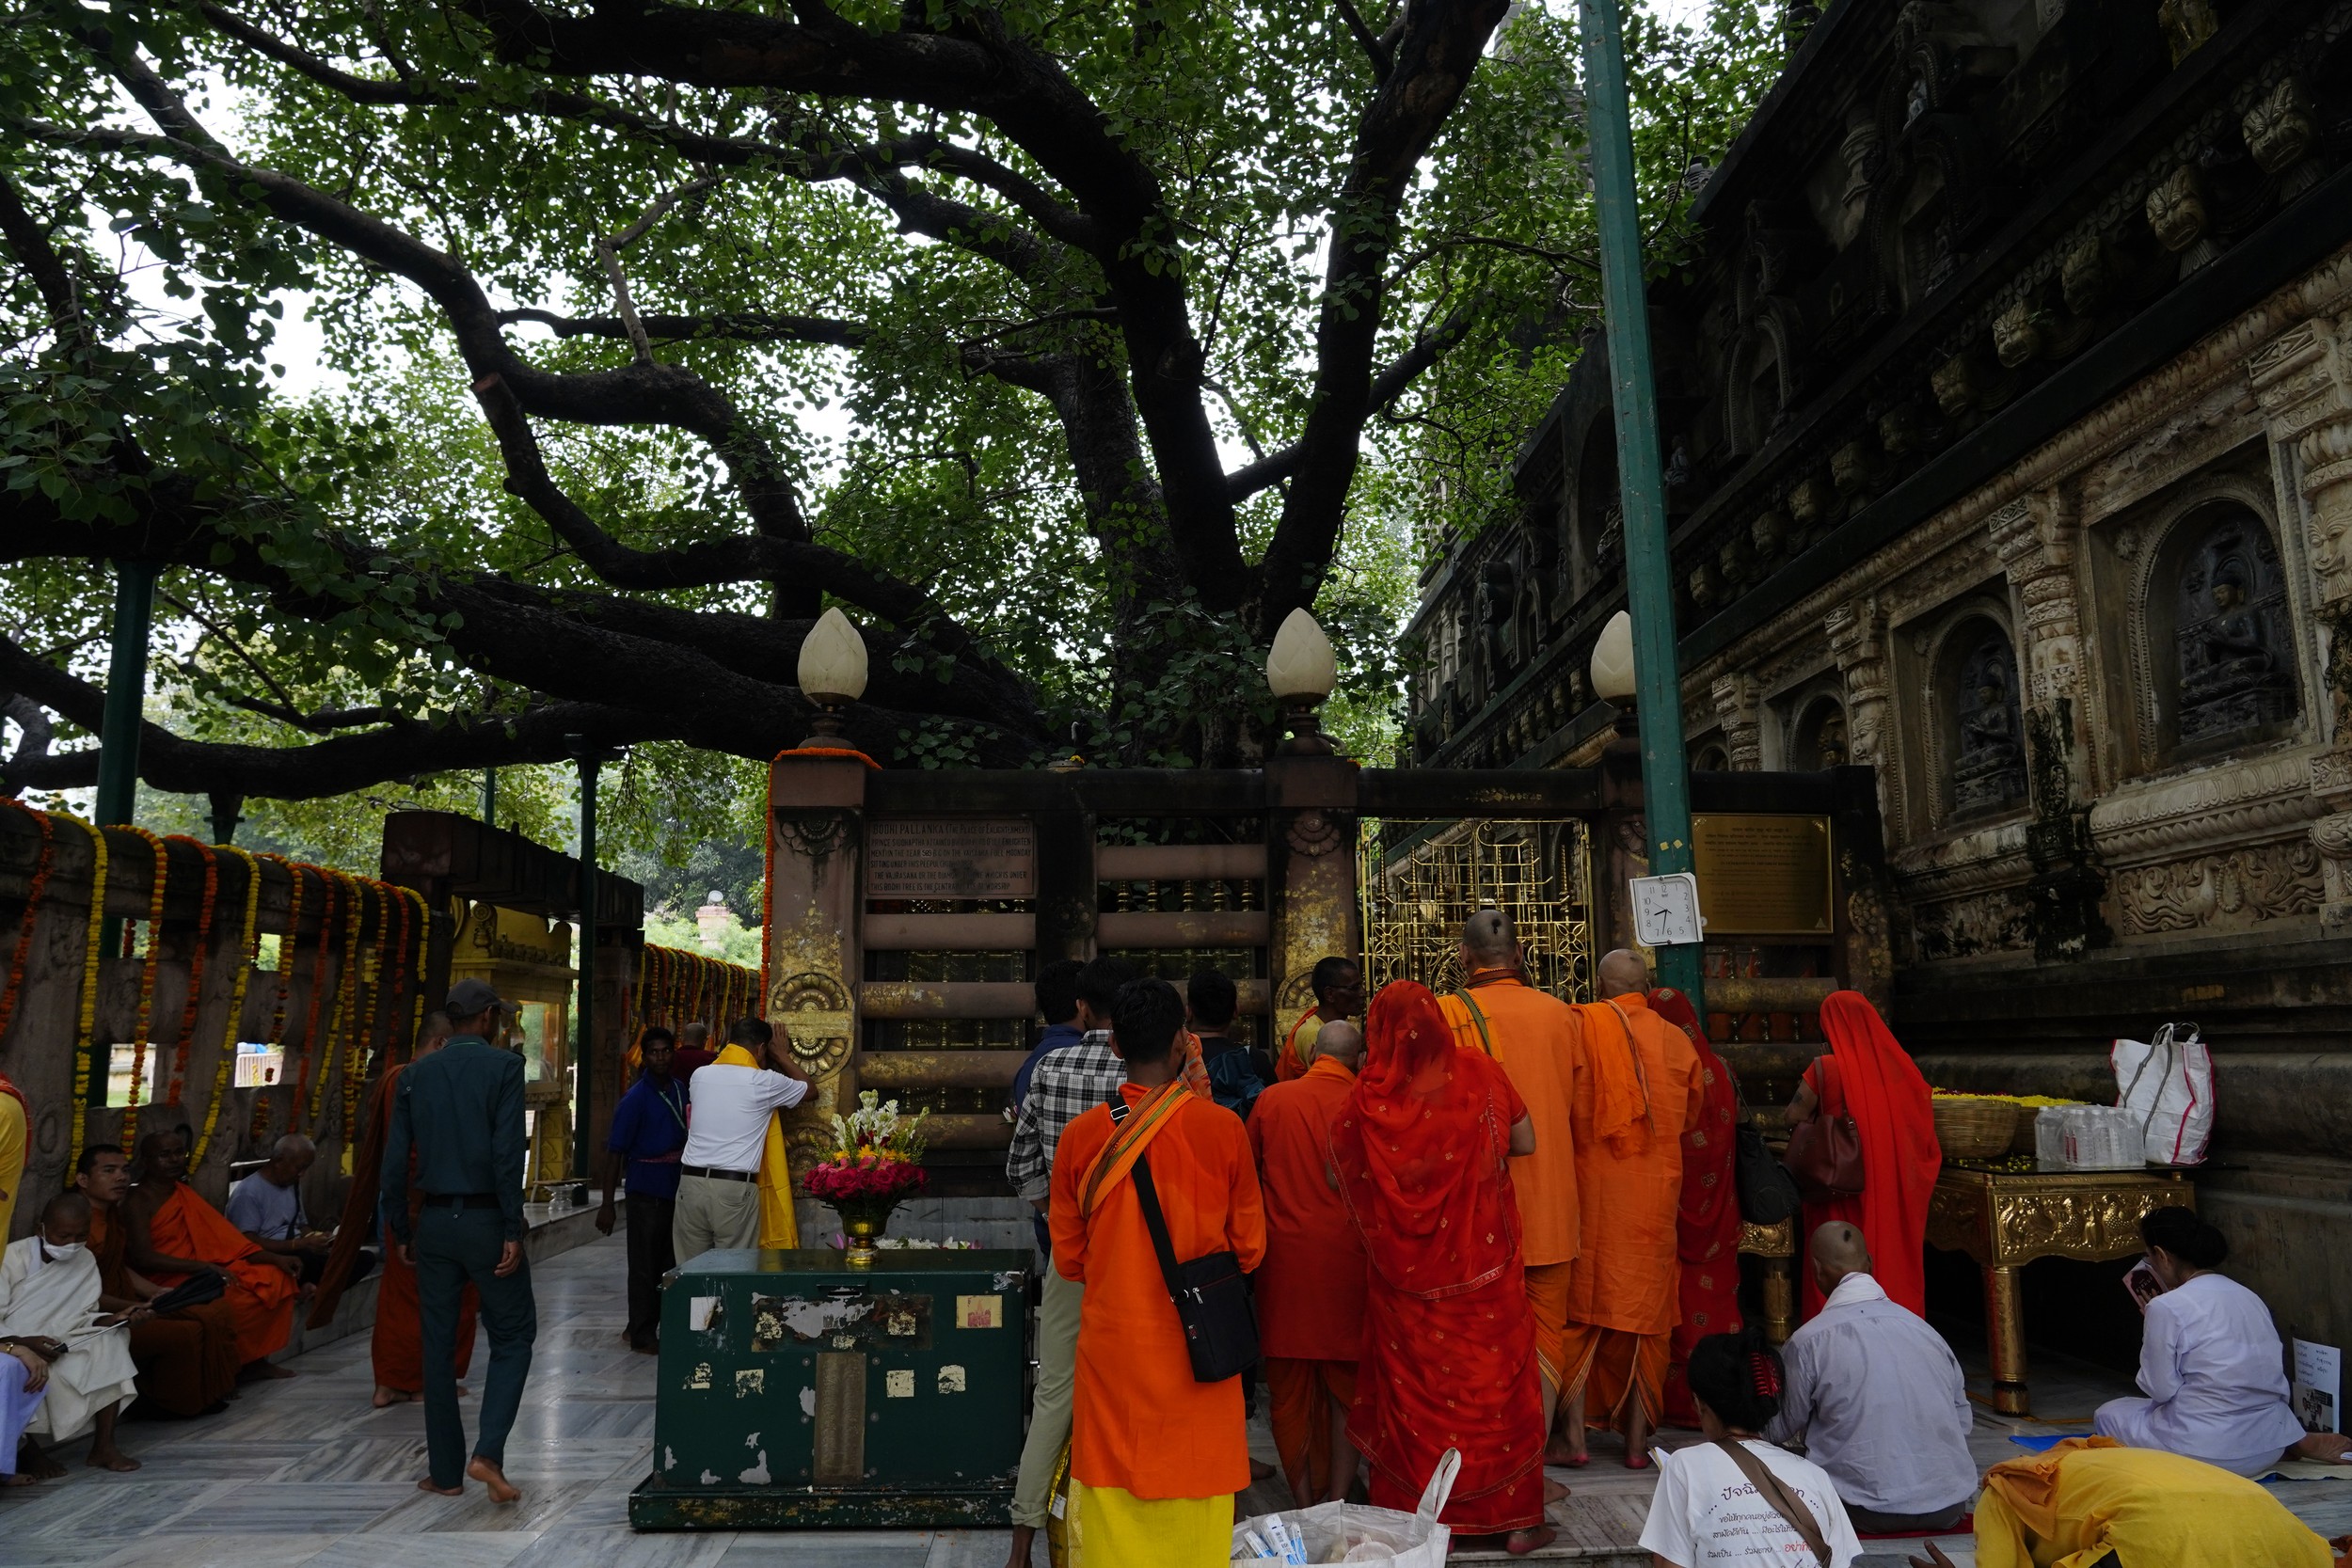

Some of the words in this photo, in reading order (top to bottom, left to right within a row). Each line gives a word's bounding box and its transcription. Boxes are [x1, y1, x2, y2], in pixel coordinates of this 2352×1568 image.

[873, 824, 898, 834] BODHI
[900, 824, 944, 834] PALLANKA
[871, 838, 890, 847] PRINCE
